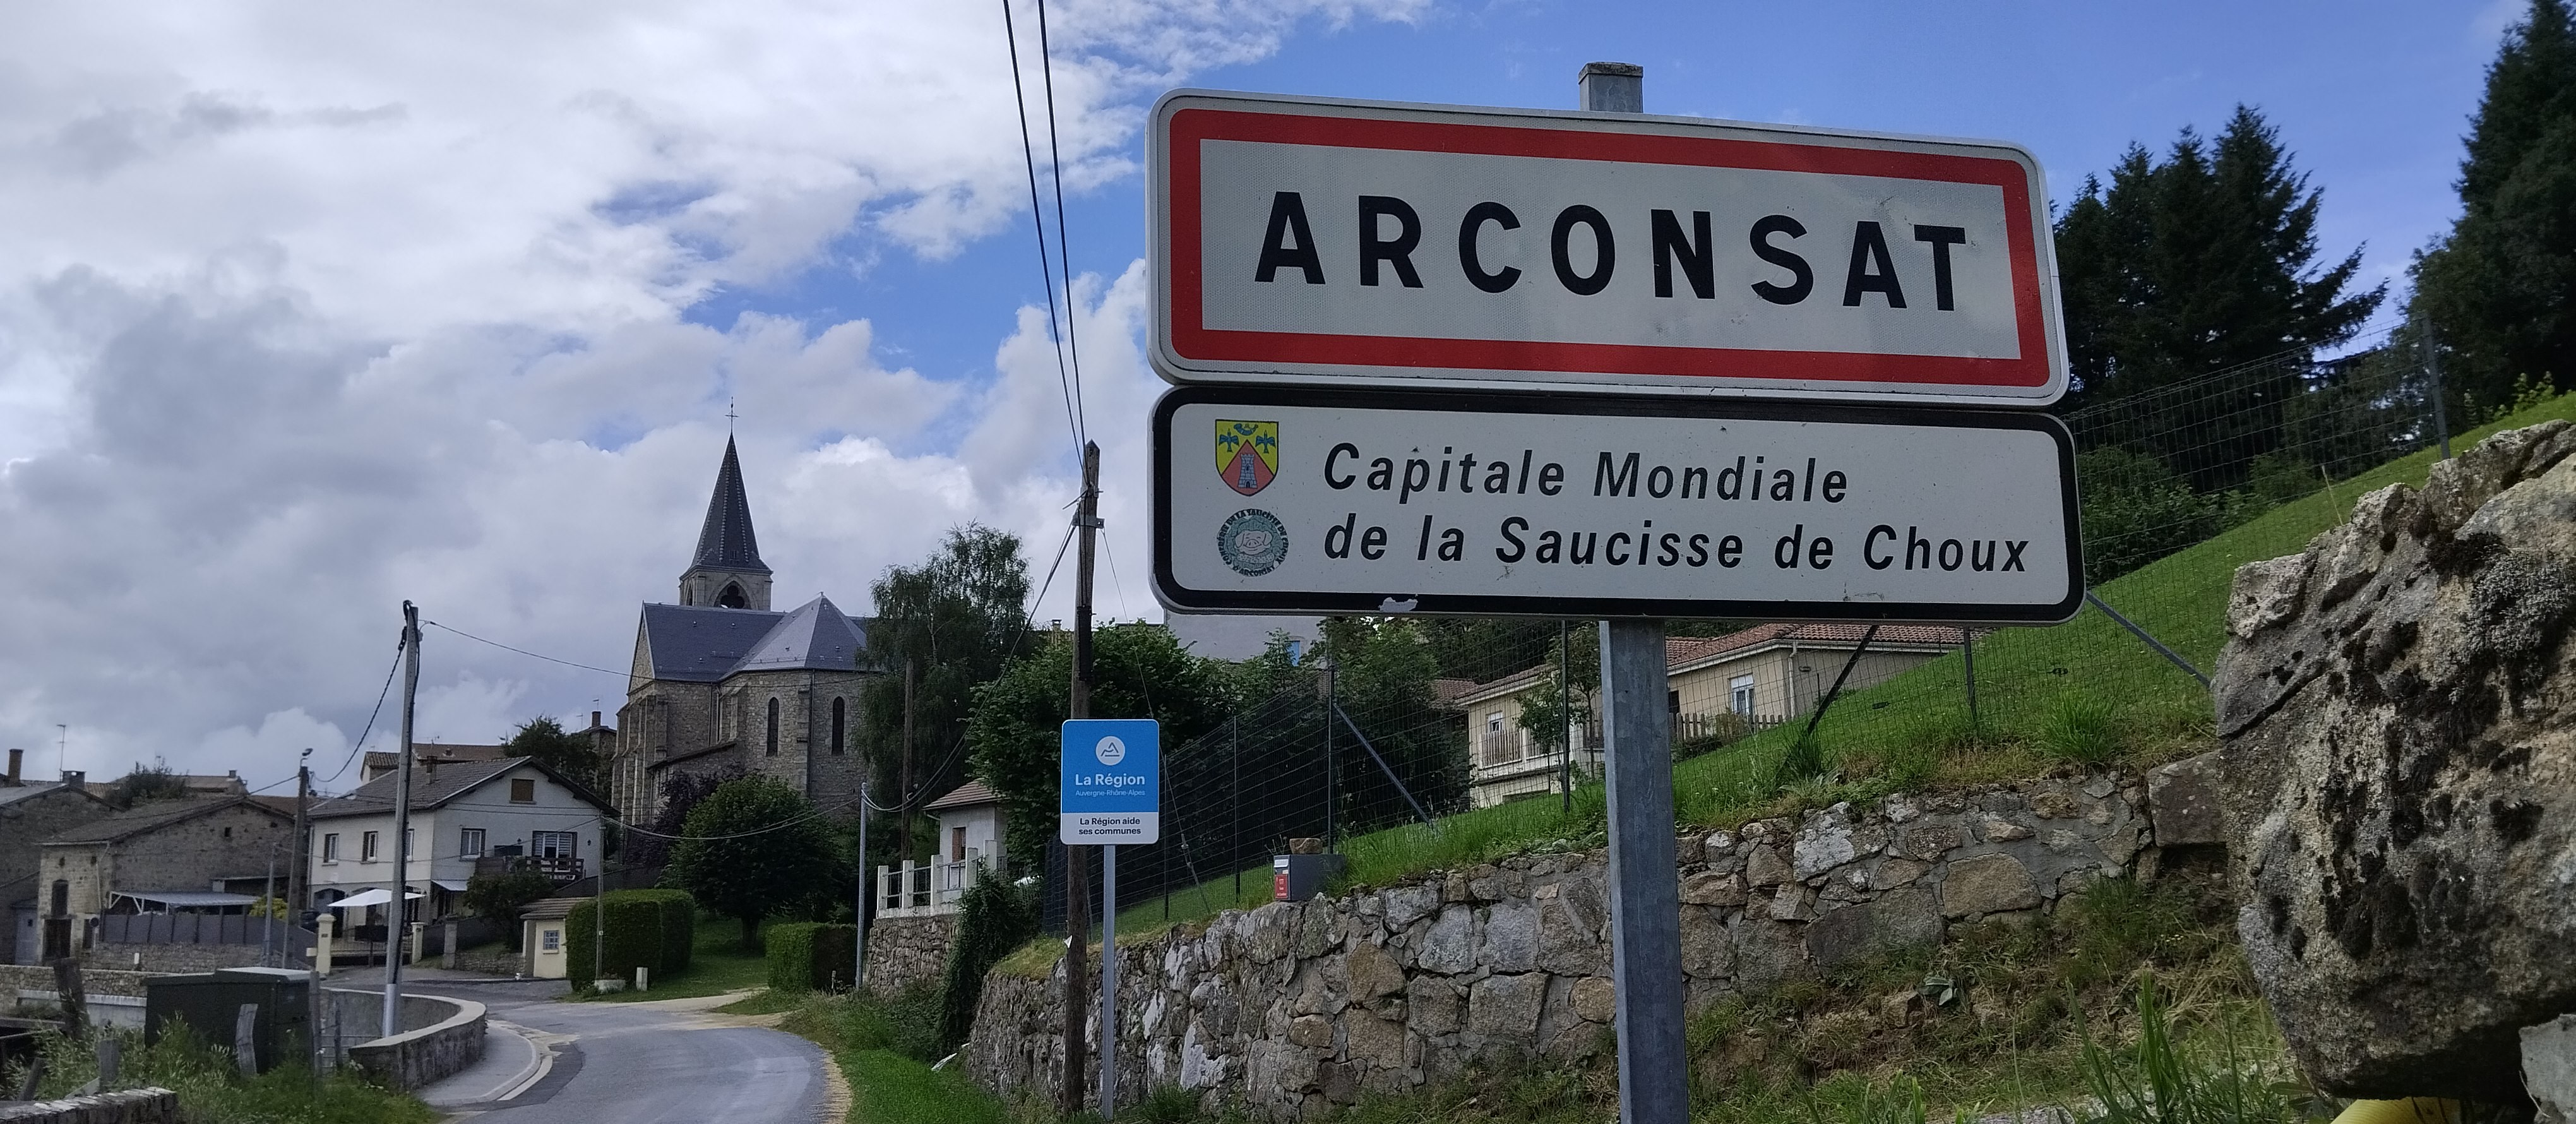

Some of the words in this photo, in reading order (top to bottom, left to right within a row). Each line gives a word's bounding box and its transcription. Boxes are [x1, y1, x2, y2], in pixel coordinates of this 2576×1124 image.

[1255, 191, 1965, 311] ARCONSAT
[1325, 443, 1564, 504] Capitale
[1594, 452, 1846, 503] Mondiale
[1325, 513, 1387, 559] de
[1417, 515, 1464, 561] la
[1496, 517, 1743, 568] Saucisse
[1775, 524, 1833, 570] de
[1864, 525, 2029, 571] Choux
[1075, 774, 1092, 786] La
[1095, 773, 1145, 787] Région
[1092, 817, 1121, 826] Région
